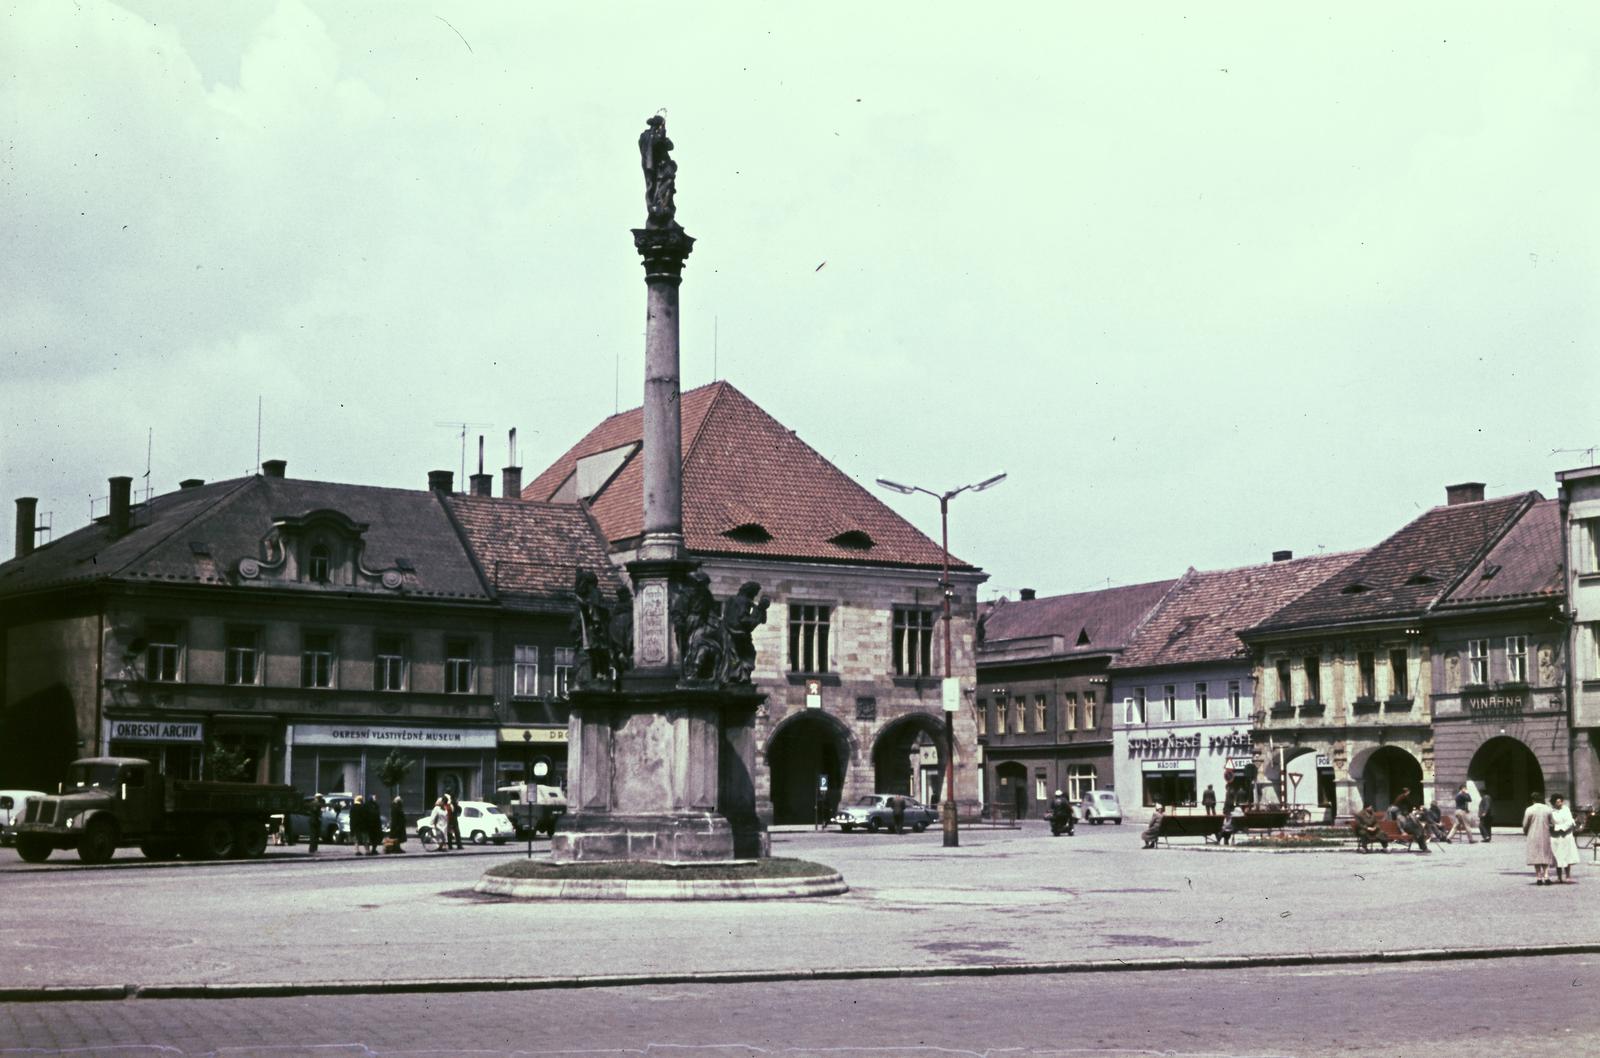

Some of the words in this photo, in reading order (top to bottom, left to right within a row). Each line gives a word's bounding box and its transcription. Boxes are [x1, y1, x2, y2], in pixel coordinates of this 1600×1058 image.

[117, 723, 160, 737] OKRESNÍ
[161, 725, 199, 738] ARCHIV
[332, 729, 371, 739] OKRESNÍ
[372, 730, 423, 740] VLASTIVĚDNÉ
[426, 732, 462, 742] MUSEUM
